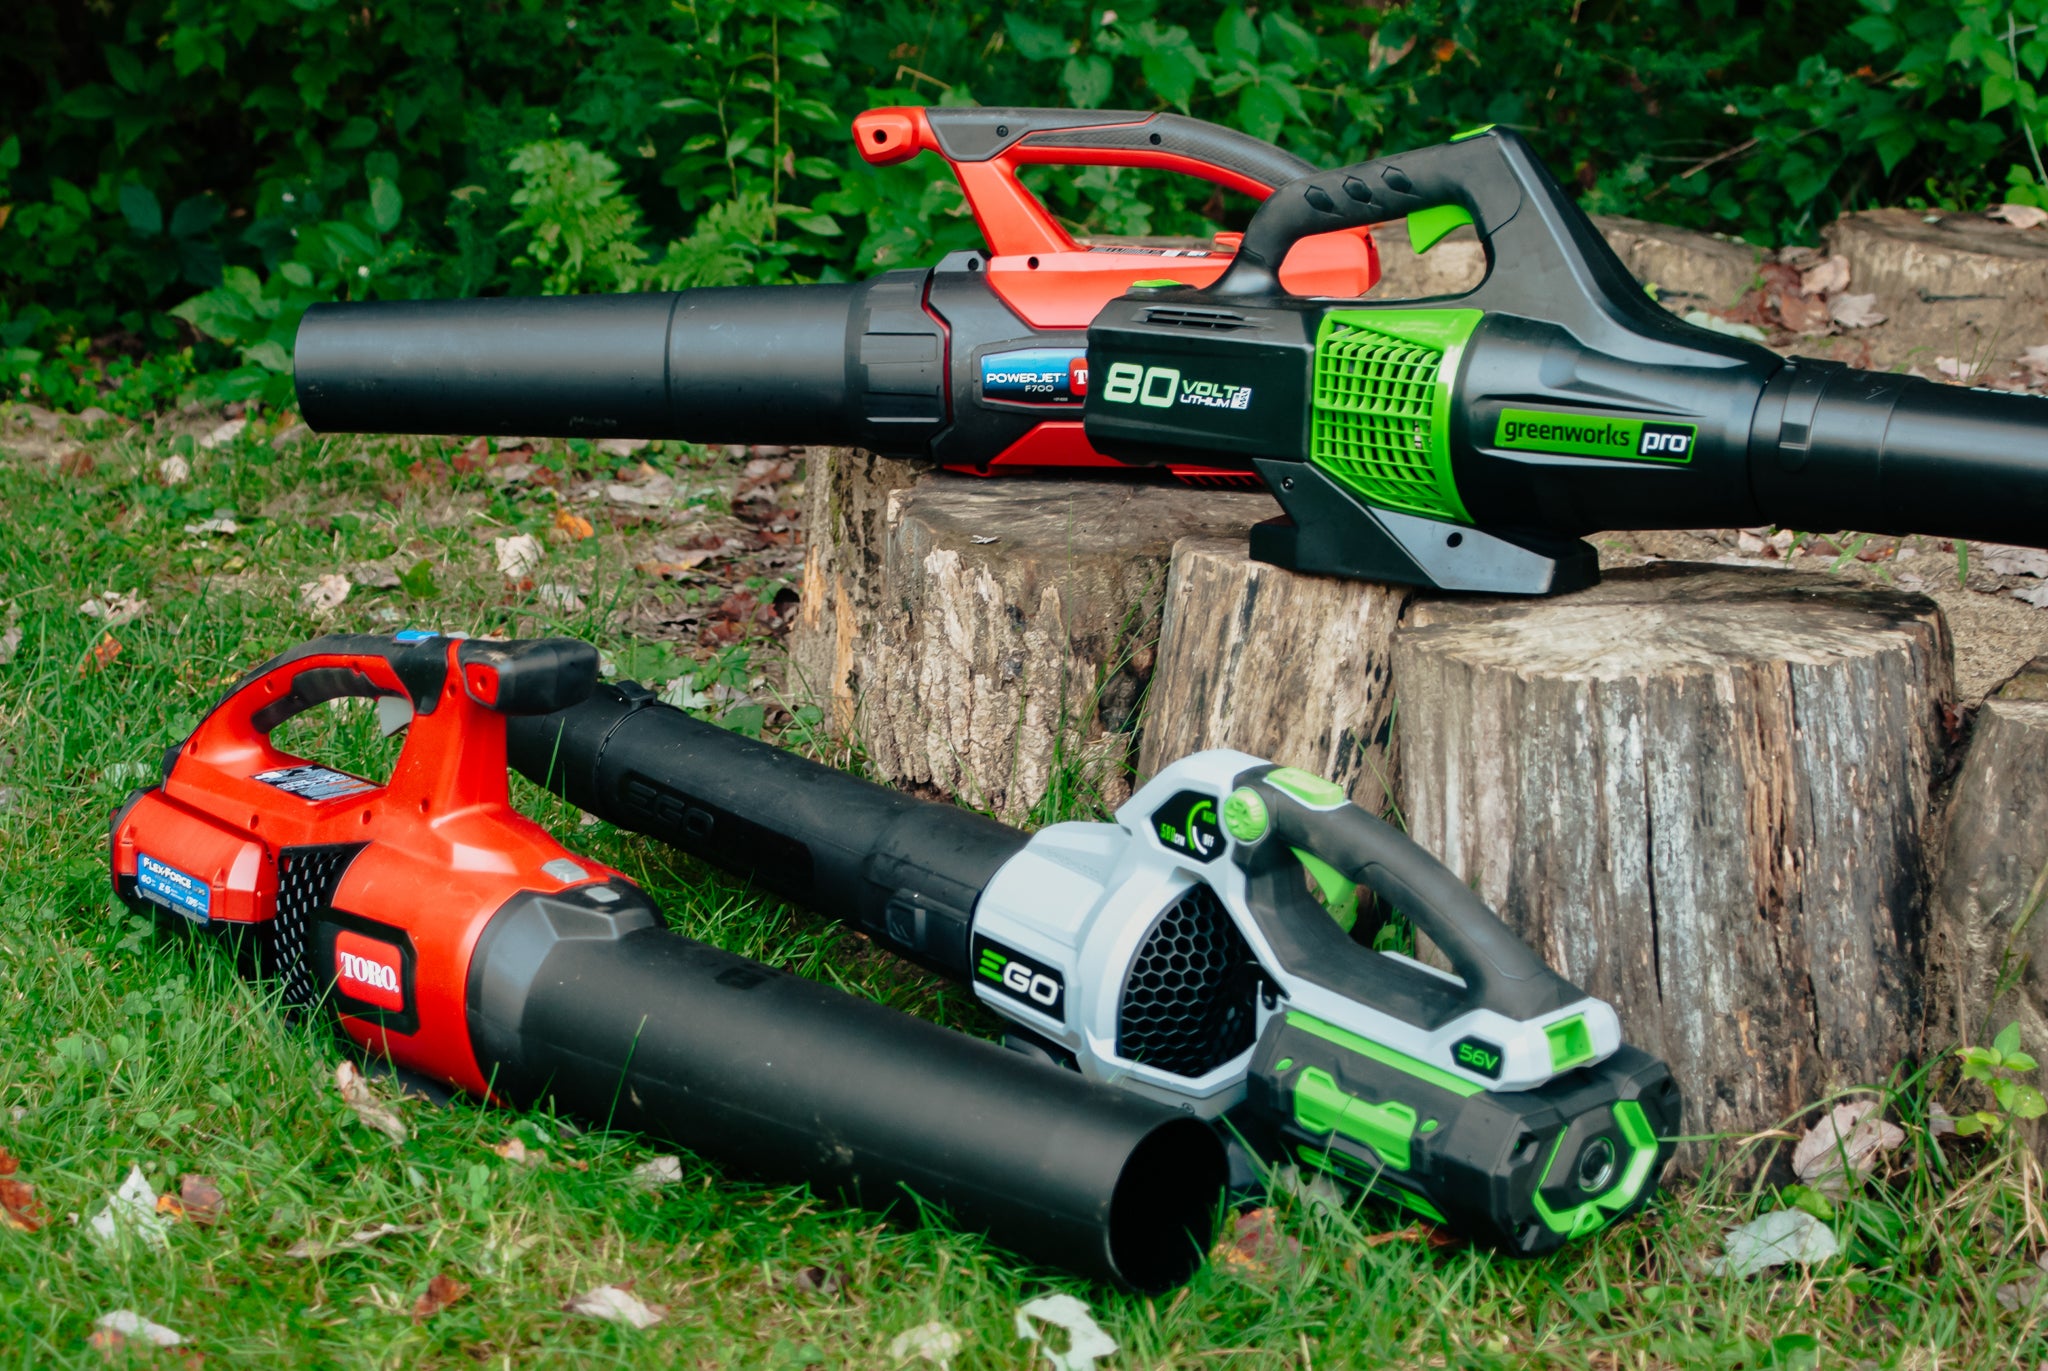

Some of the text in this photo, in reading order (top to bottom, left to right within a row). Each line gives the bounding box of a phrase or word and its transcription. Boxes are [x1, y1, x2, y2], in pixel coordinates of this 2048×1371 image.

[1024, 384, 1055, 393] F700
[1103, 362, 1240, 408] 80 VOLT
[1180, 393, 1231, 409] LITHIUM
[1504, 420, 1688, 454] greenworks pro
[978, 948, 1059, 1006] EGO
[1459, 1043, 1499, 1070] 56V
